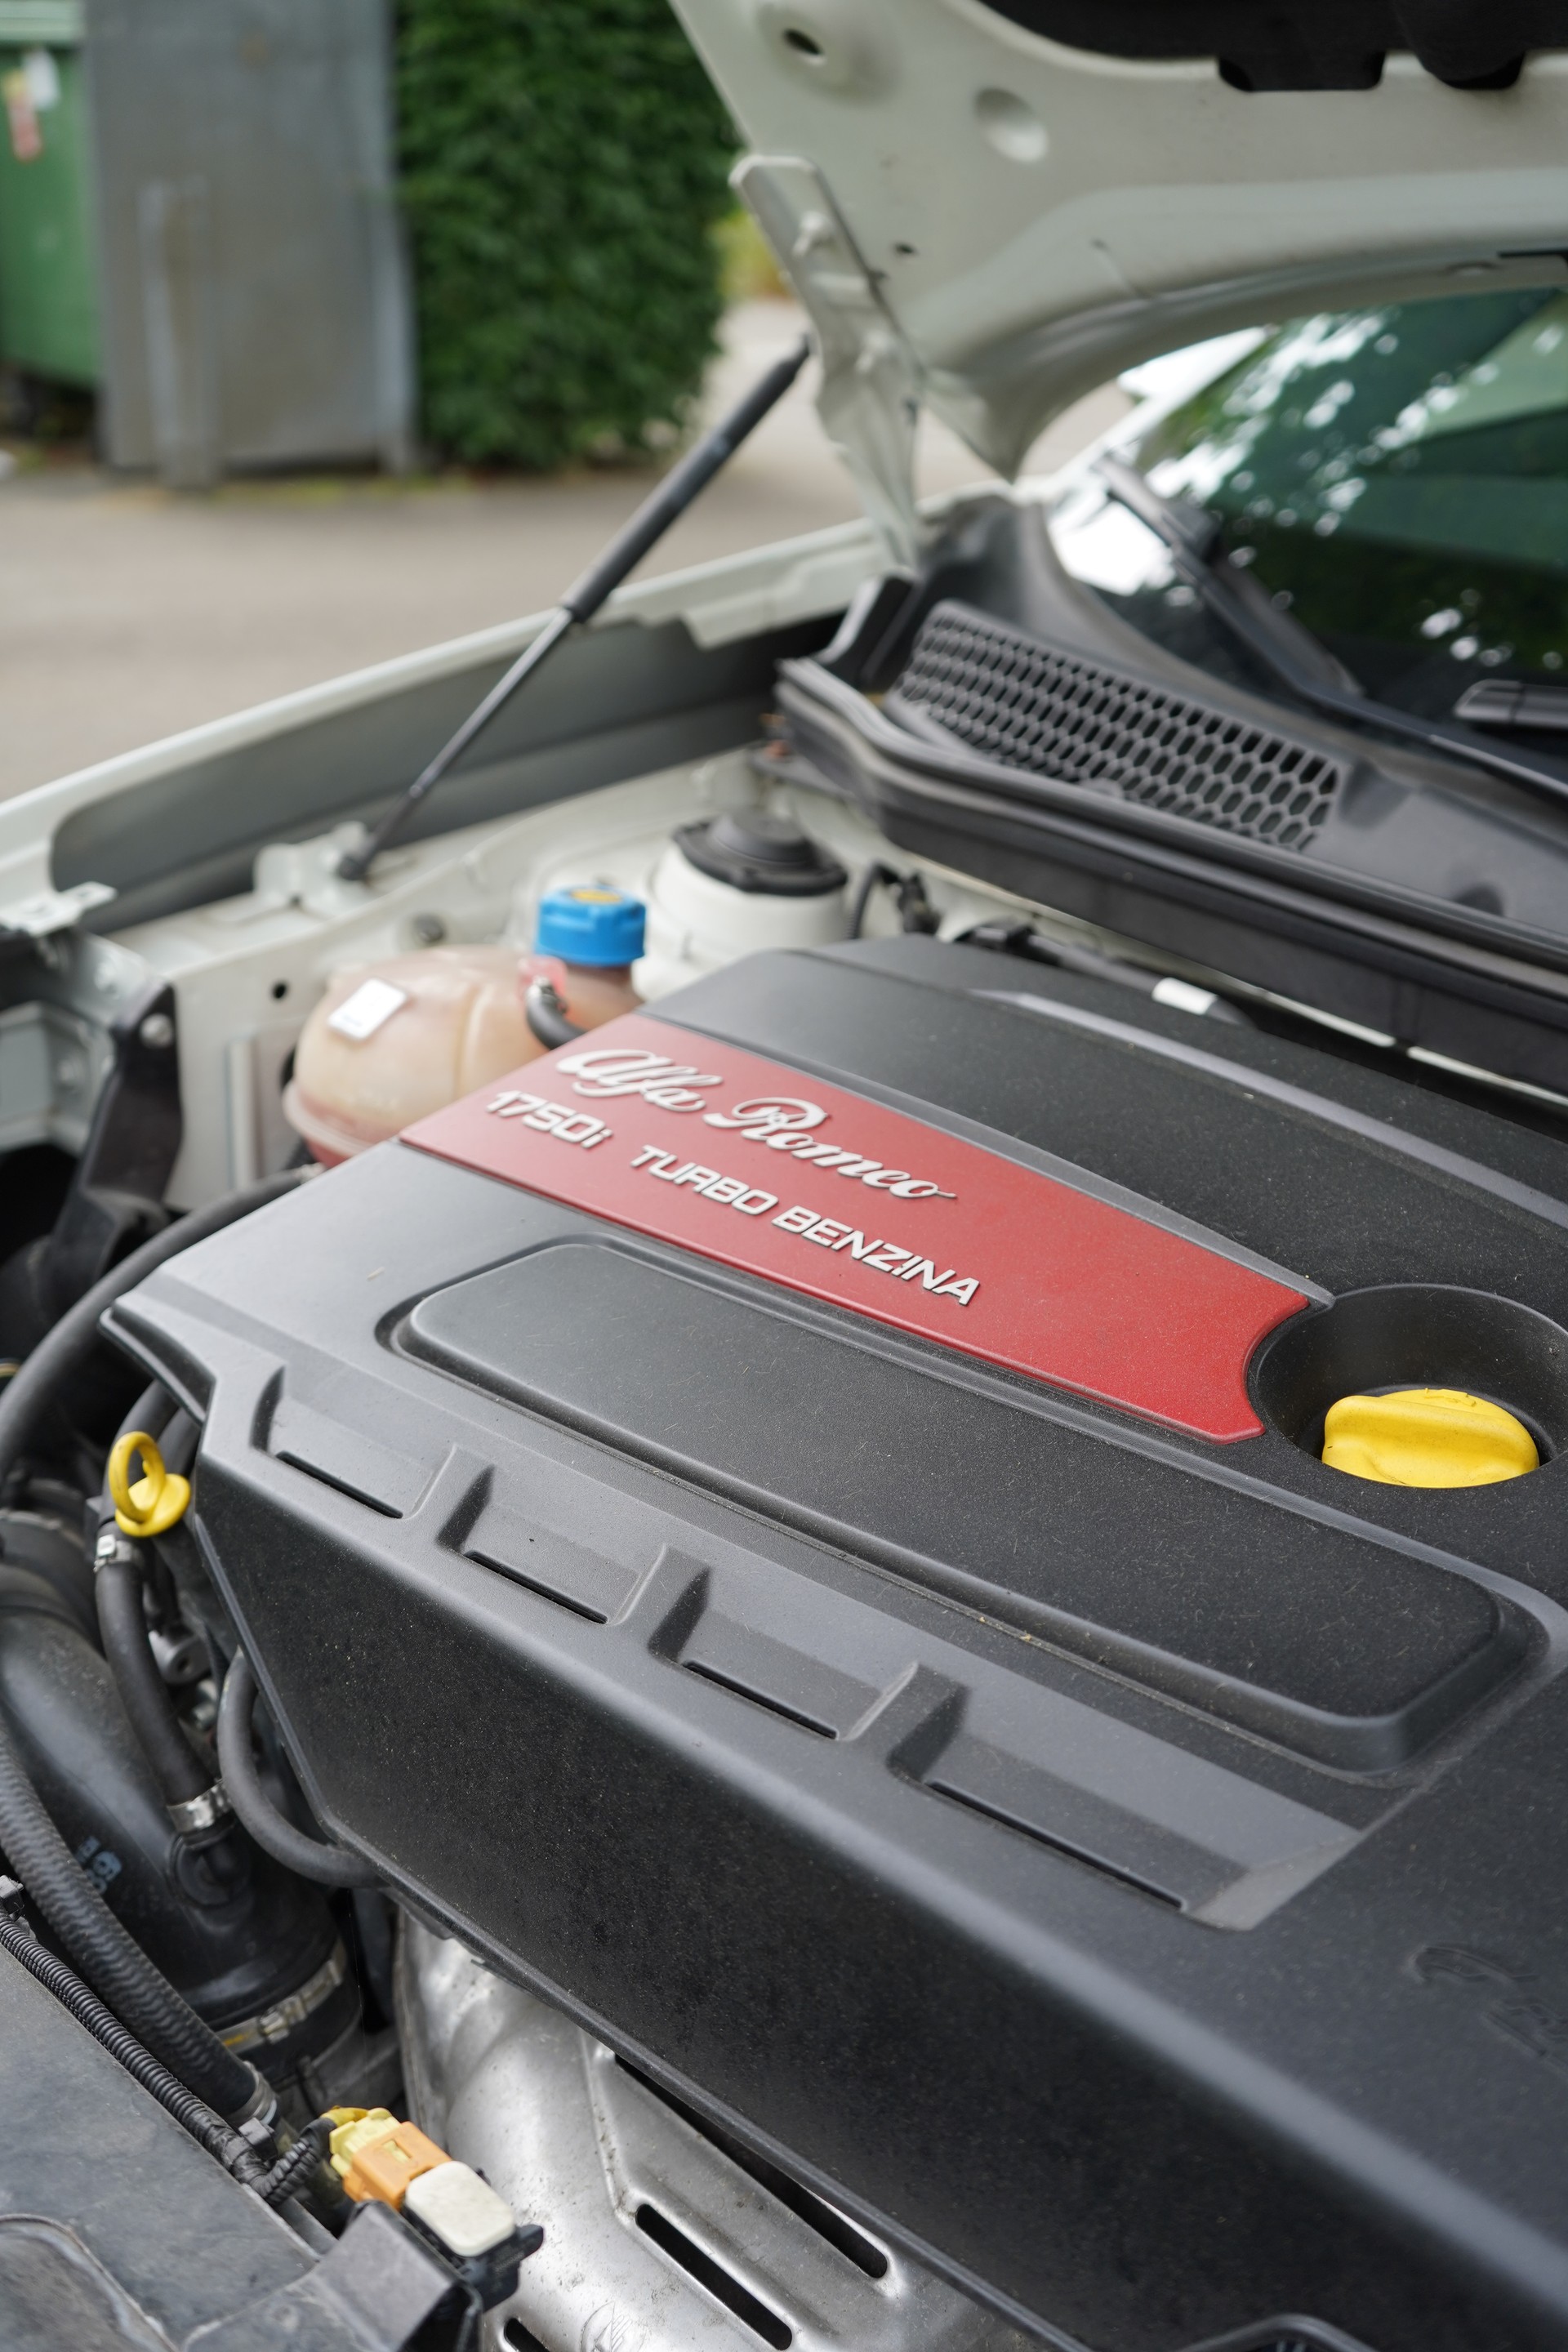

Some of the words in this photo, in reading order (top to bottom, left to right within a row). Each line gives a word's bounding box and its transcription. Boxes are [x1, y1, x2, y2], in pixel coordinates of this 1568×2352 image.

[486, 1089, 613, 1148] 1750i
[630, 1145, 778, 1216] TURBO
[772, 1205, 980, 1306] BENZINA
[556, 1049, 723, 1112] Alfa
[703, 1096, 958, 1199] Romeo
